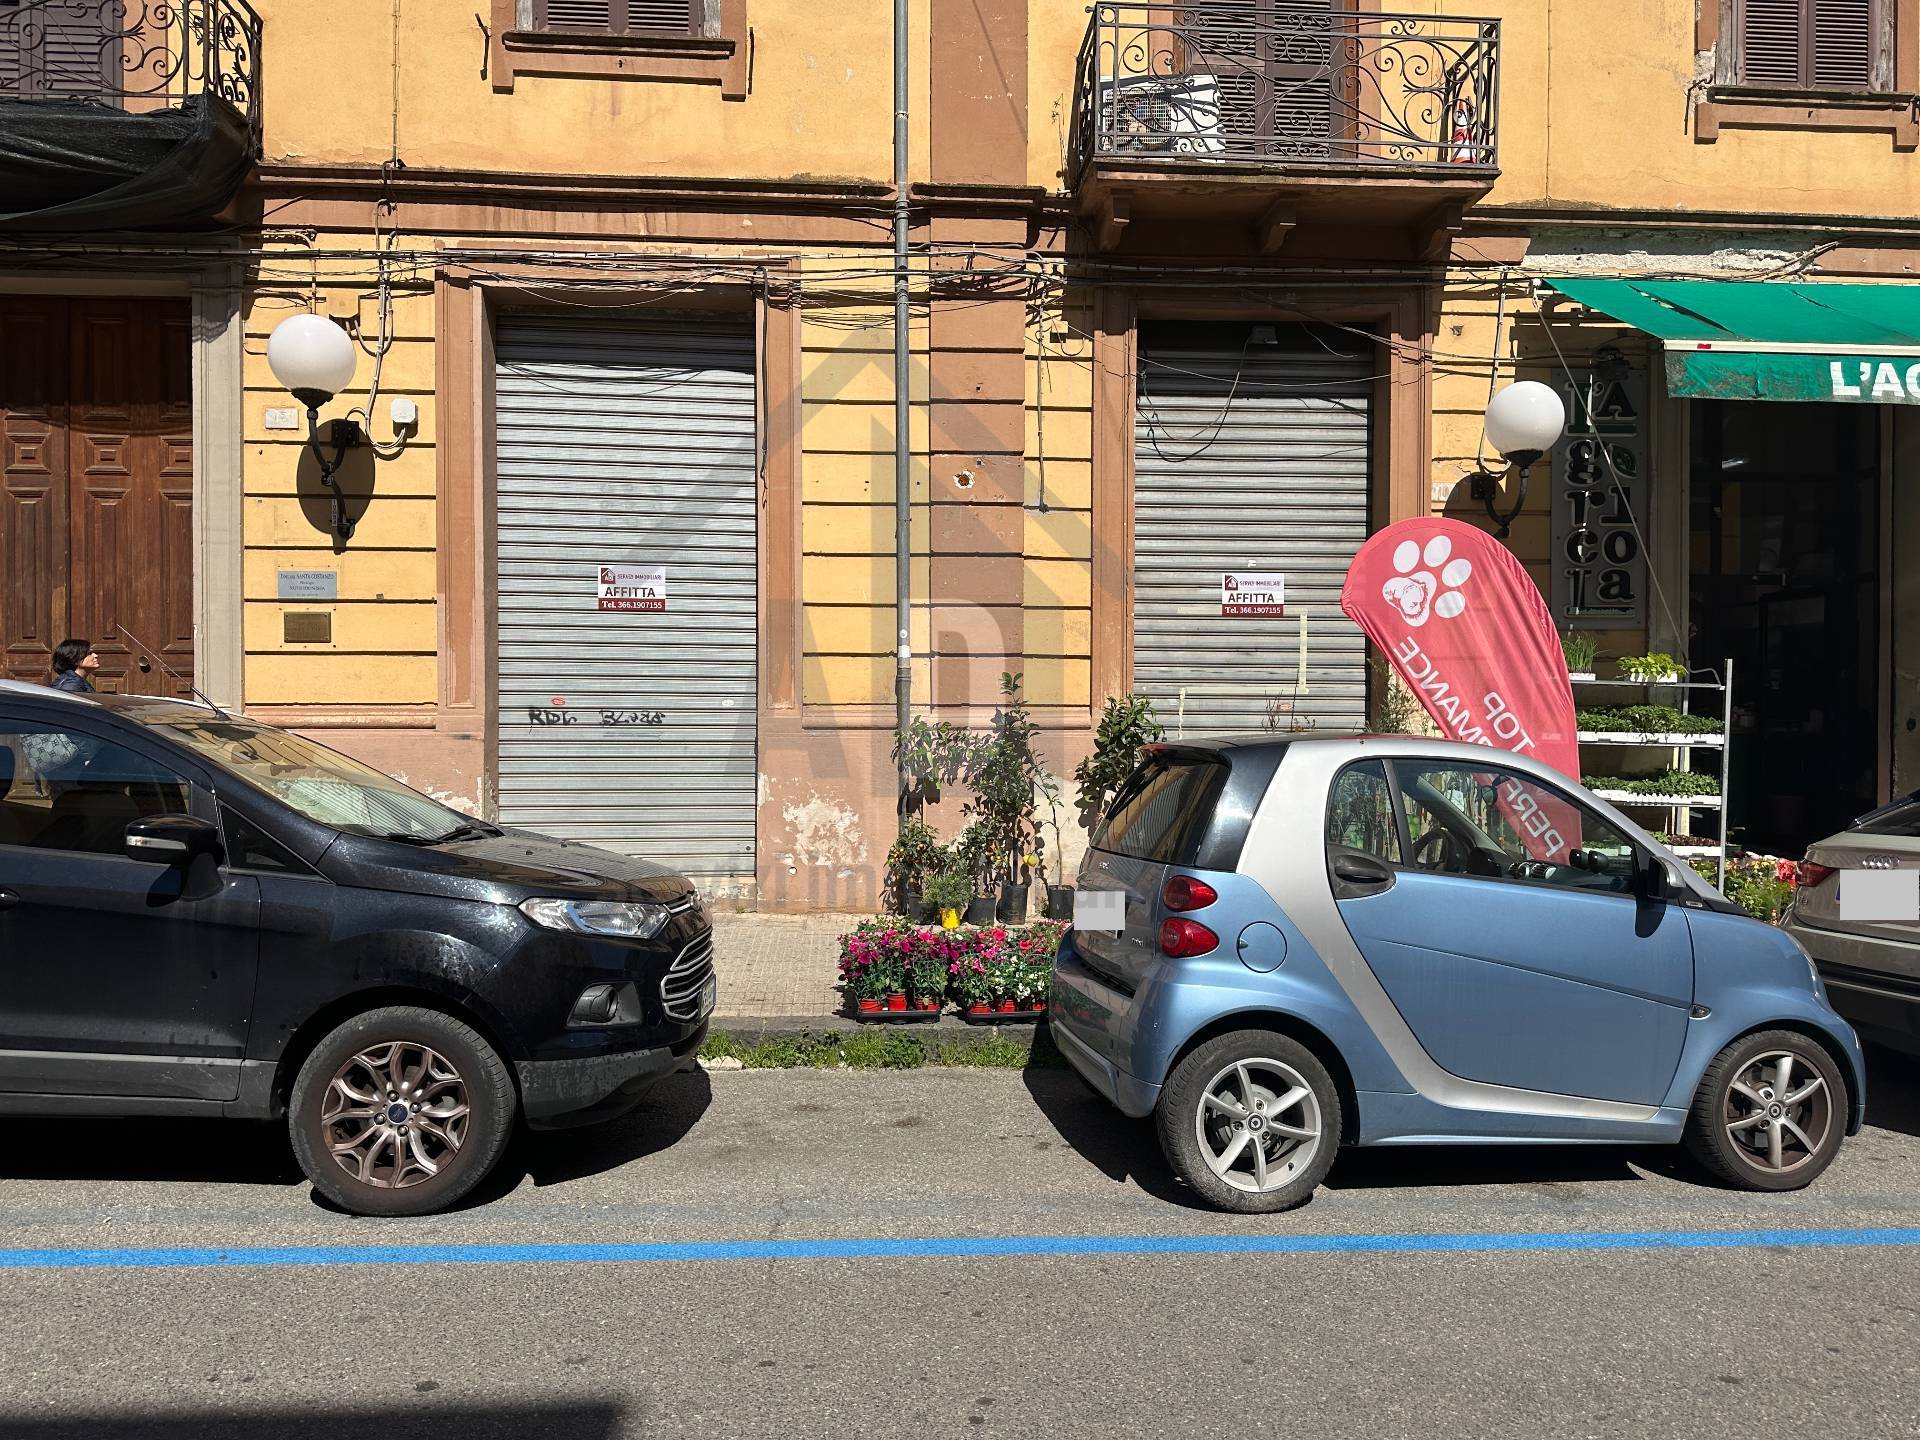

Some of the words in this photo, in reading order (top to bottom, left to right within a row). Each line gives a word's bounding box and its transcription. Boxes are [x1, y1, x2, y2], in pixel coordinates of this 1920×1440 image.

[604, 586, 656, 597] AFFITTA
[1228, 592, 1275, 603] AFFITTA
[618, 601, 662, 609] 366.1907155
[1224, 606, 1239, 614] Tel.
[1240, 606, 1281, 614] 366.1907155
